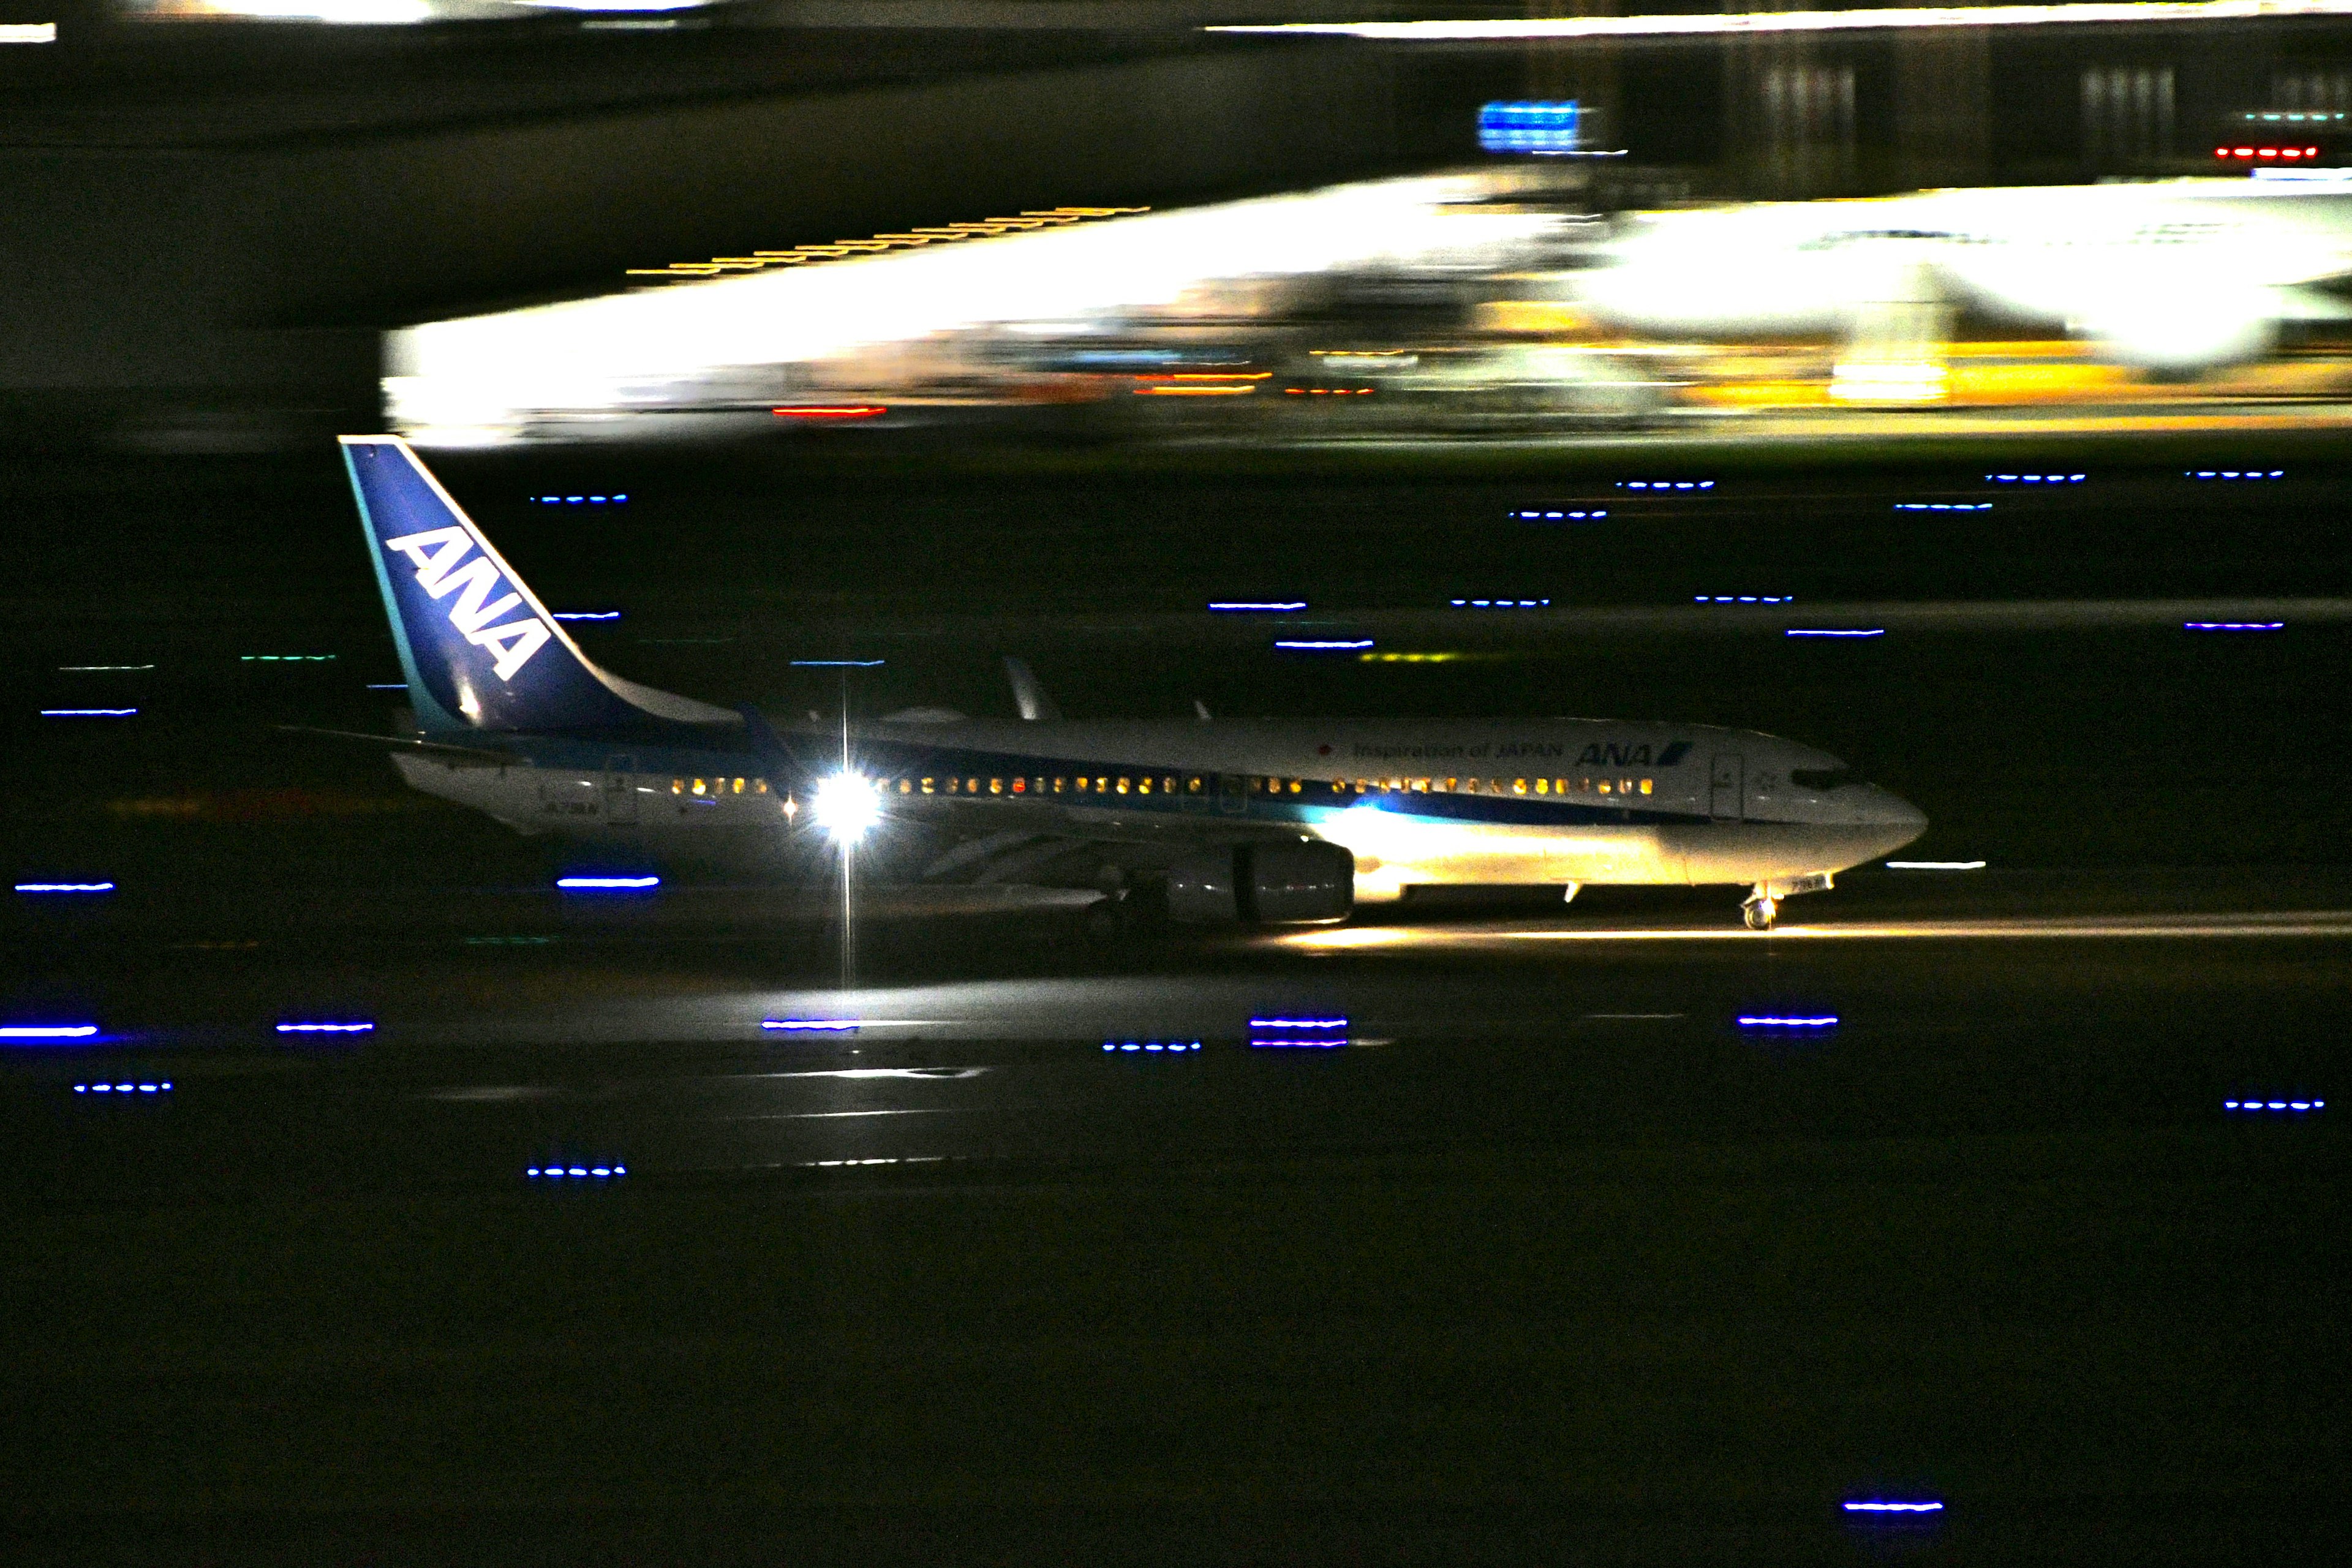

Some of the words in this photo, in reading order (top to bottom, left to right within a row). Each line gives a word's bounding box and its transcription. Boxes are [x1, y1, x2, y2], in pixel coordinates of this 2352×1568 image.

[385, 526, 552, 682] ANA
[1354, 742, 1463, 760] Inspiration
[1469, 743, 1490, 757] of
[1494, 742, 1562, 758] JAPAN
[1574, 742, 1650, 767] ANA
